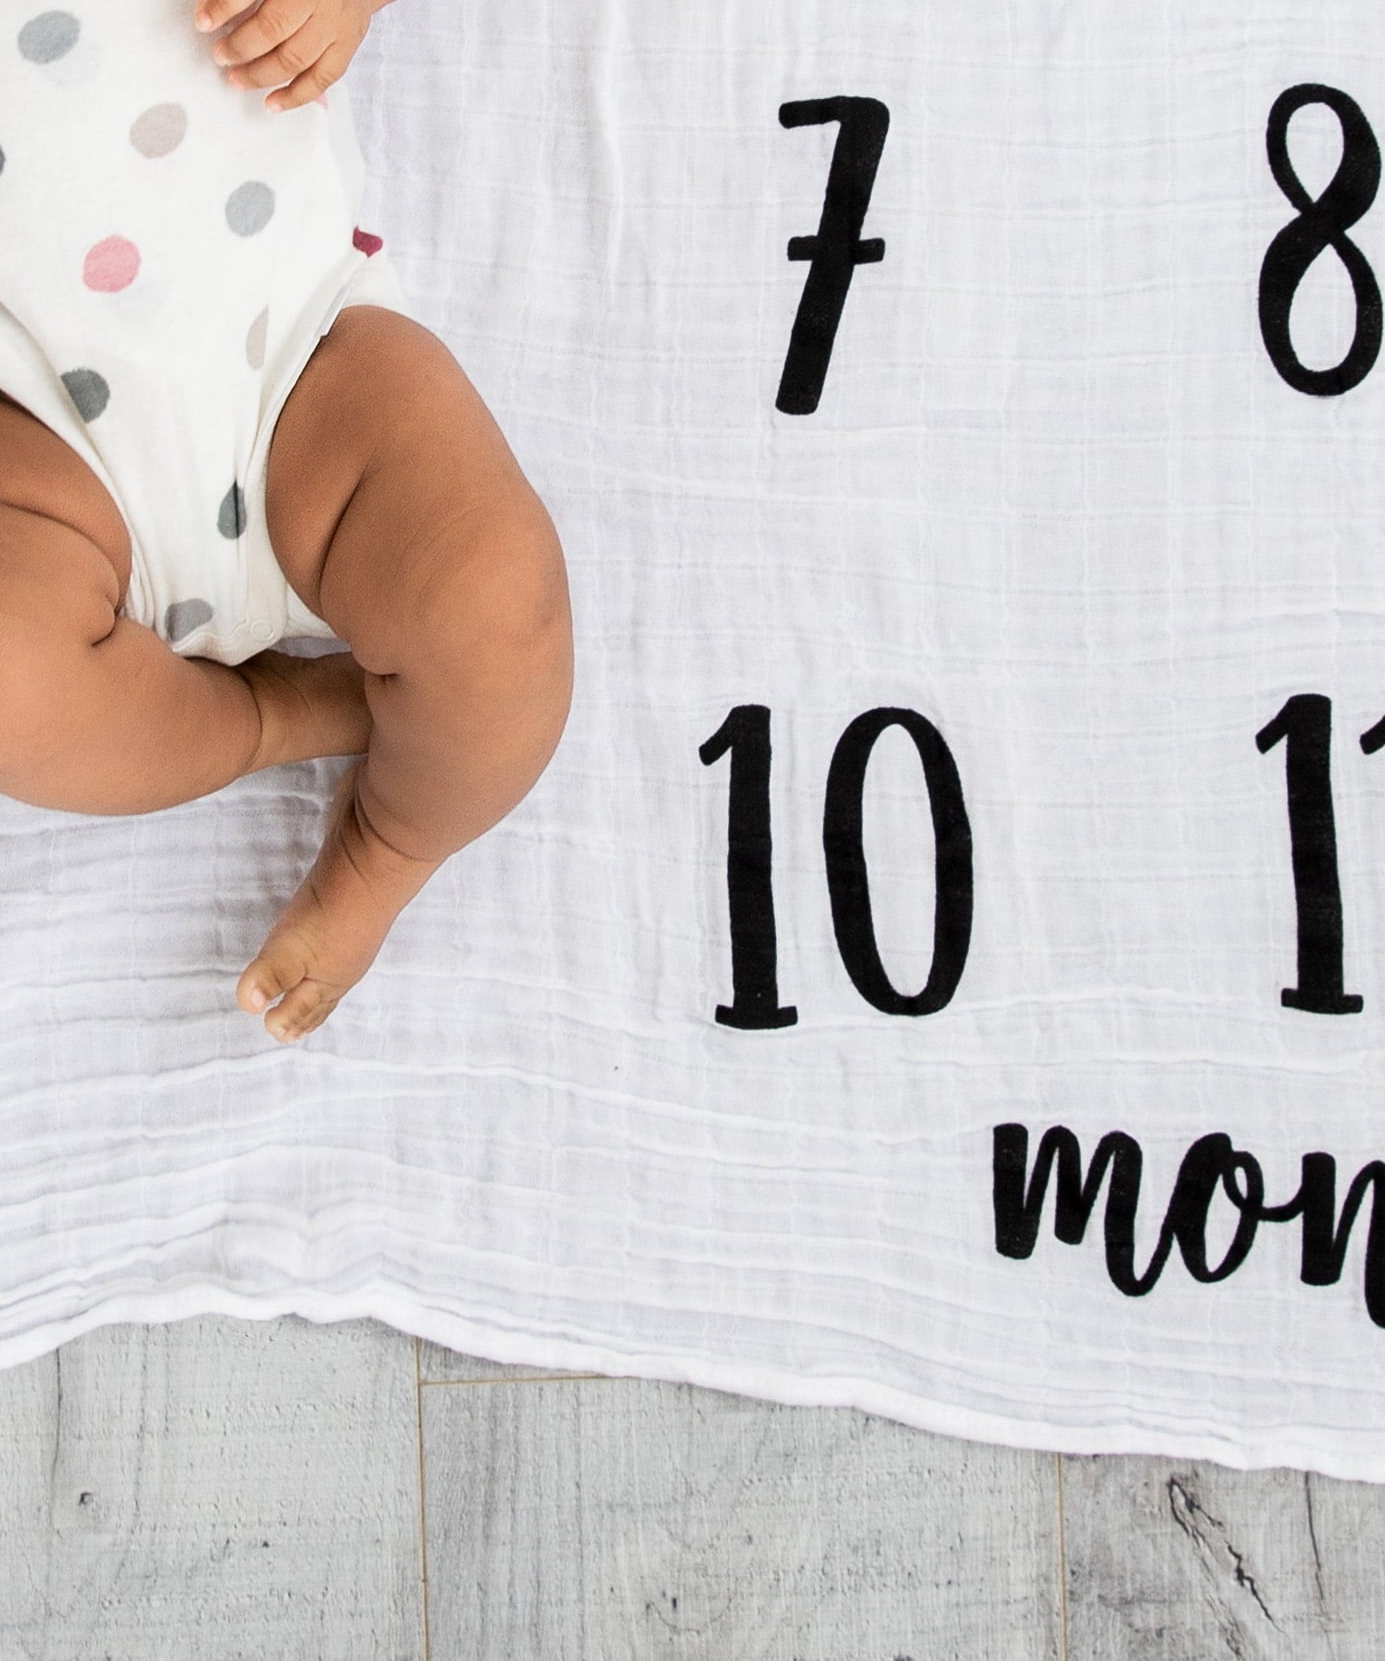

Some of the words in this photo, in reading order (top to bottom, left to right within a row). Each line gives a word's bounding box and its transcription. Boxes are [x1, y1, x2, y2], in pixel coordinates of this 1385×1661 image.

[776, 96, 889, 415] 7
[1258, 83, 1383, 397] 8
[699, 704, 973, 1030] 10
